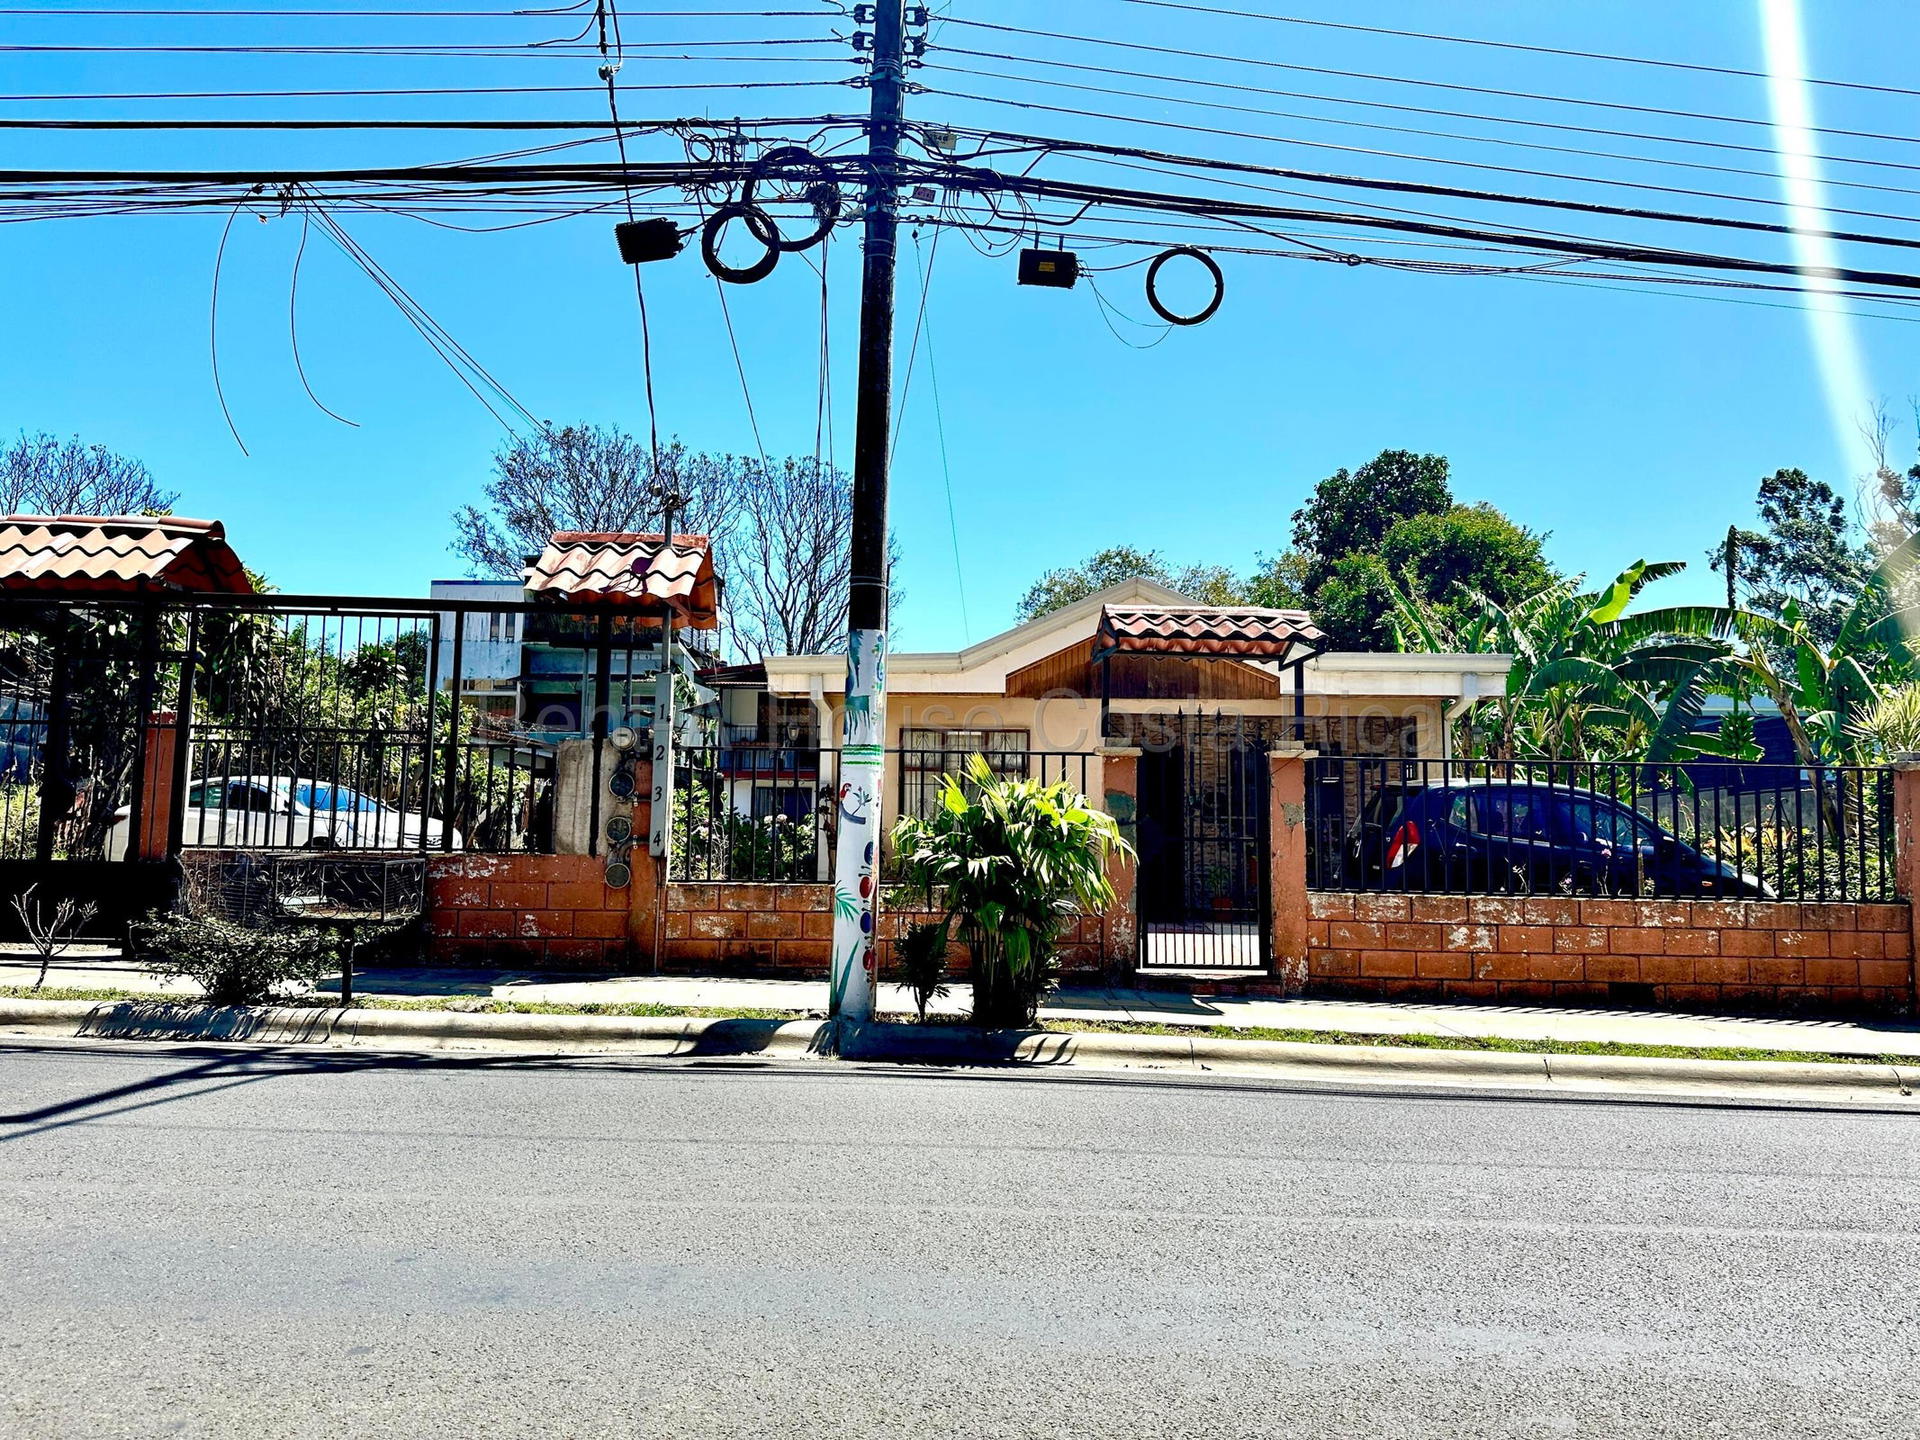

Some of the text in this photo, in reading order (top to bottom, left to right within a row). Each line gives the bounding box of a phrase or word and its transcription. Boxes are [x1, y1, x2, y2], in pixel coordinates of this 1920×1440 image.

[660, 703, 666, 720] 1
[655, 744, 665, 761] 2
[653, 785, 663, 802] 3
[652, 830, 662, 847] 4
